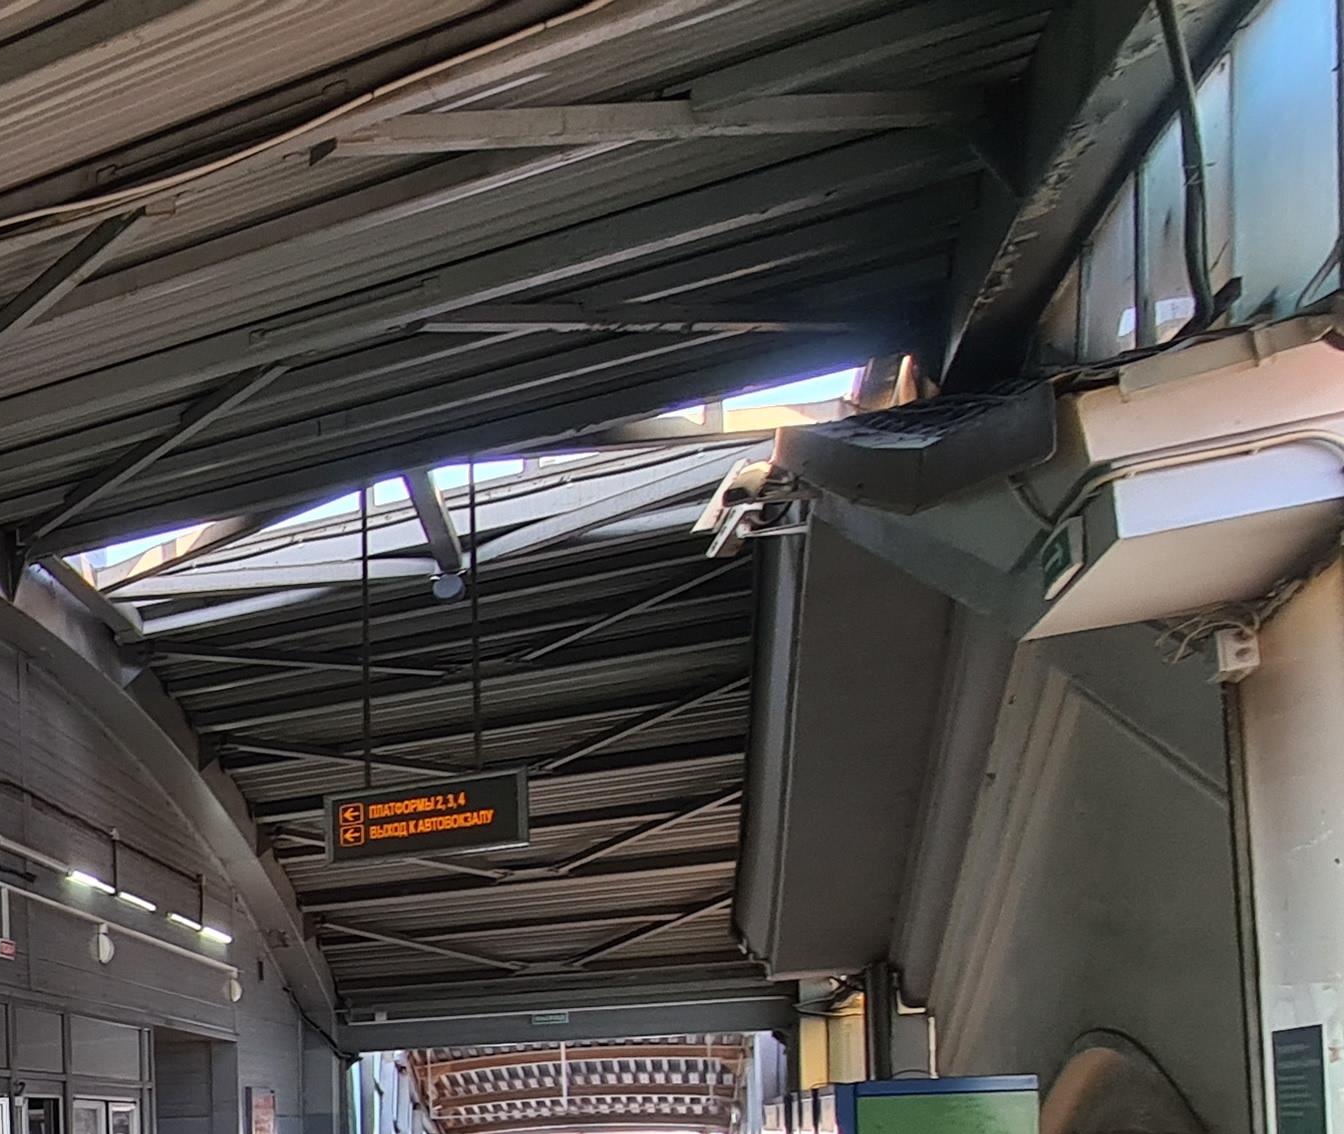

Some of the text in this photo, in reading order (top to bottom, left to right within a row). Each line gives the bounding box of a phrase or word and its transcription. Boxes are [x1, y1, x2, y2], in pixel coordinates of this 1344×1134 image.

[369, 801, 436, 819] ПЛАТФОРМЫ
[369, 809, 494, 839] ВЫХОД К АВТОВОКЗАЛУ
